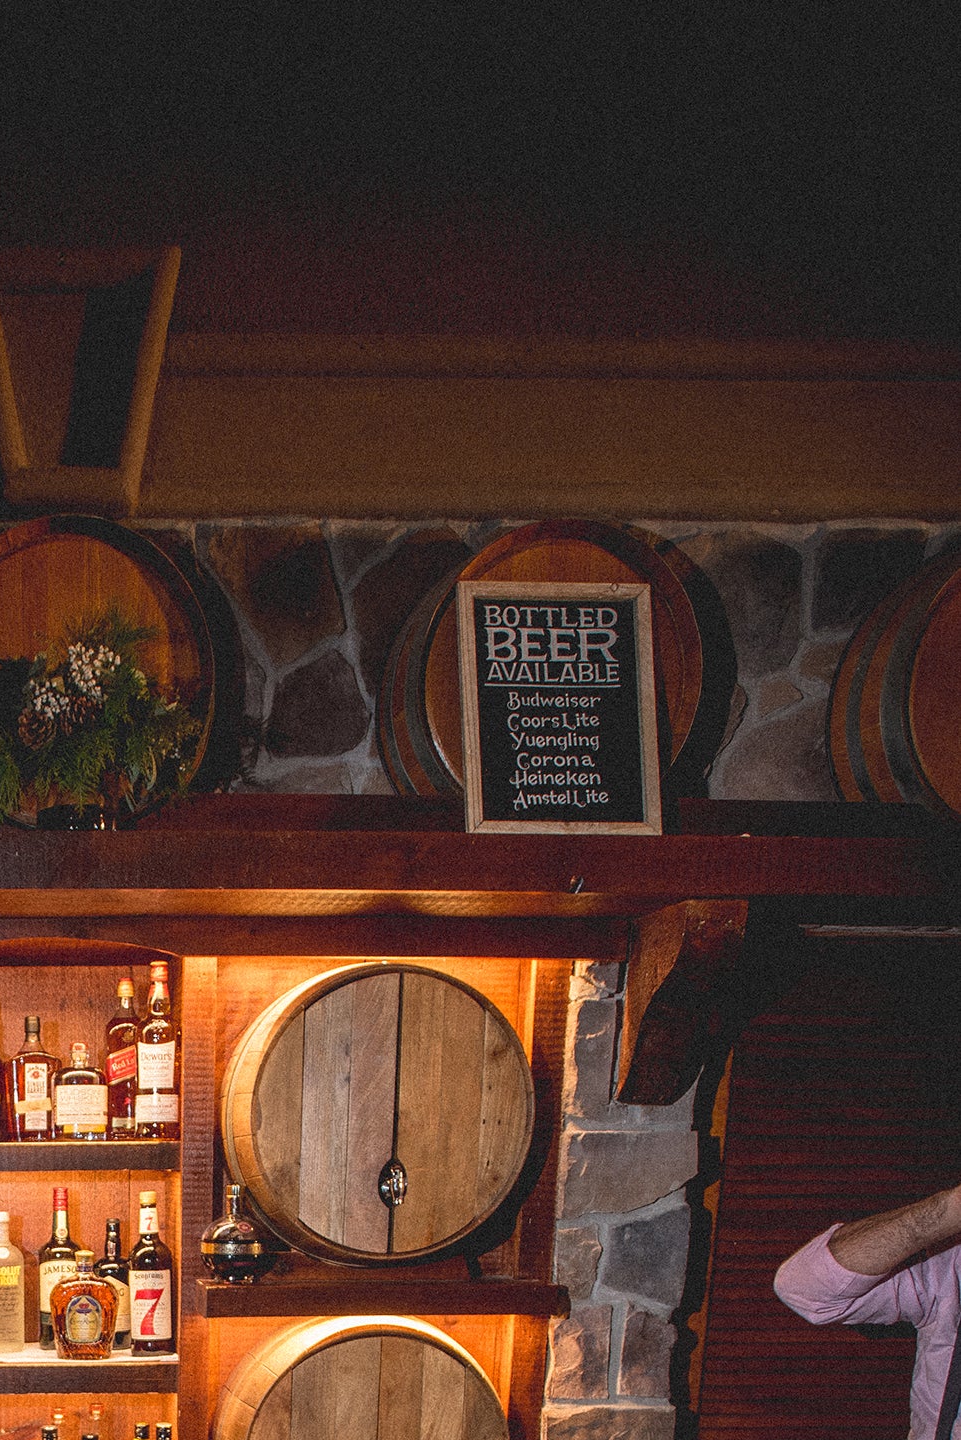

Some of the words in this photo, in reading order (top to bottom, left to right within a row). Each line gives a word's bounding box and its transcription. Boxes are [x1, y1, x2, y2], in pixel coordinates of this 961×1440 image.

[484, 605, 619, 629] BOTTLED
[484, 626, 619, 663] BEER
[486, 662, 621, 684] AVAILABLE
[506, 691, 601, 711] Budweiser
[507, 713, 560, 732] Coors
[562, 712, 601, 731] Lite
[509, 732, 600, 751] Yuengling
[516, 752, 595, 771] Corona
[509, 770, 602, 789] Heineken
[512, 790, 570, 812] Amstel
[572, 788, 609, 808] Lite
[111, 1059, 126, 1071] Red
[145, 1216, 153, 1231] 7
[44, 1264, 77, 1275] JAMESO
[135, 1288, 165, 1336] 7
